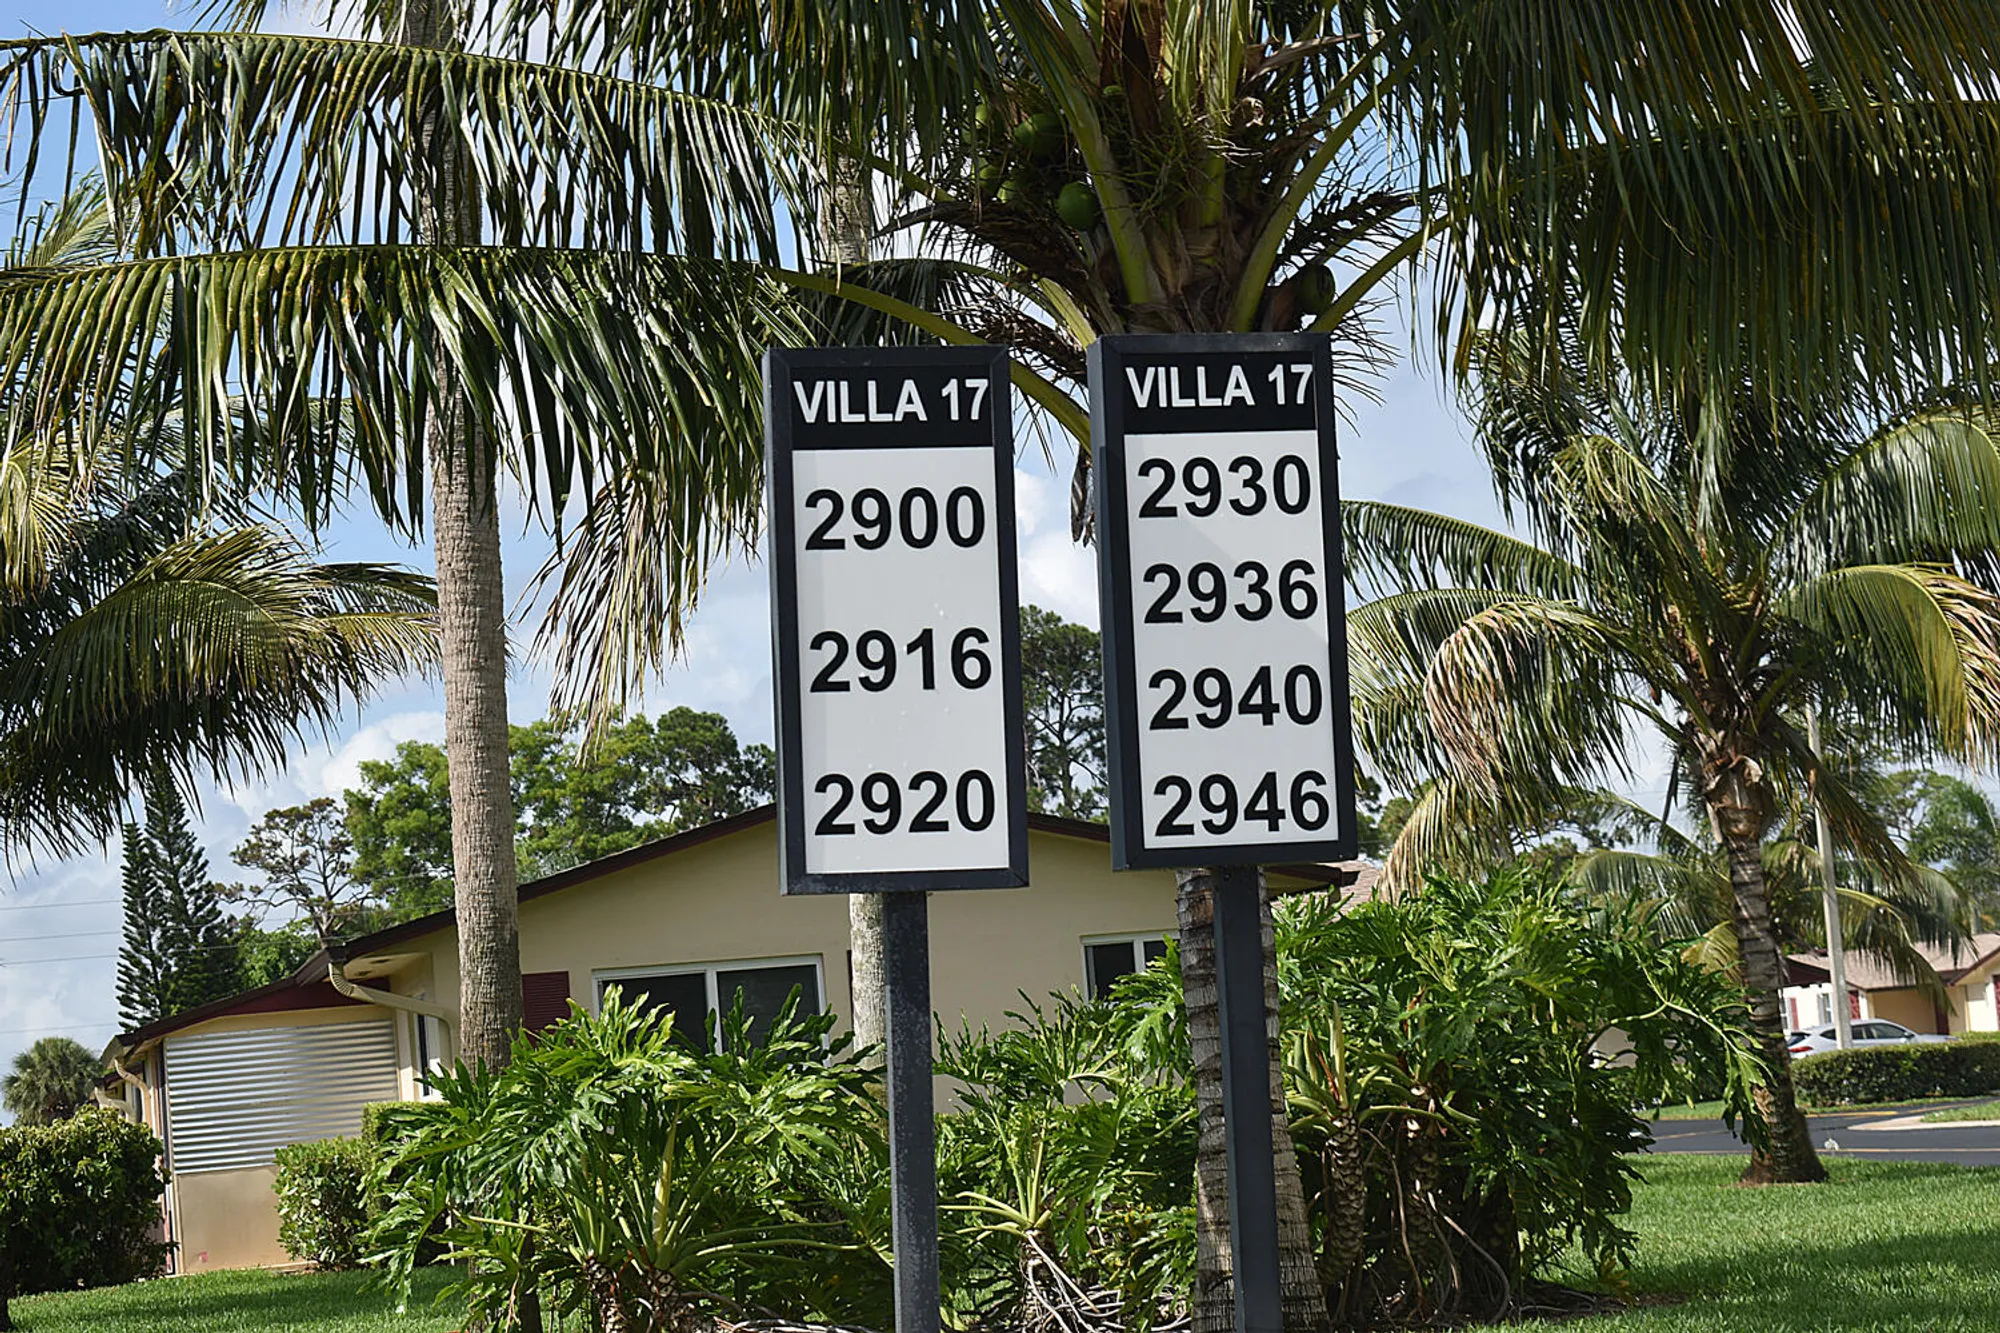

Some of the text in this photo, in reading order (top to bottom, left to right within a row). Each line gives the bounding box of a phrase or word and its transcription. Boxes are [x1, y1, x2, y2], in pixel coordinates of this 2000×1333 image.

[793, 378, 989, 423] VILLA 17
[1125, 364, 1313, 408] VILLA 17
[804, 485, 986, 551] 2900
[1137, 454, 1311, 519] 2930
[1142, 559, 1319, 624] 2936
[809, 627, 992, 694] 2916
[1148, 664, 1323, 731] 2940
[814, 769, 996, 836] 2920
[1153, 770, 1330, 837] 2946
